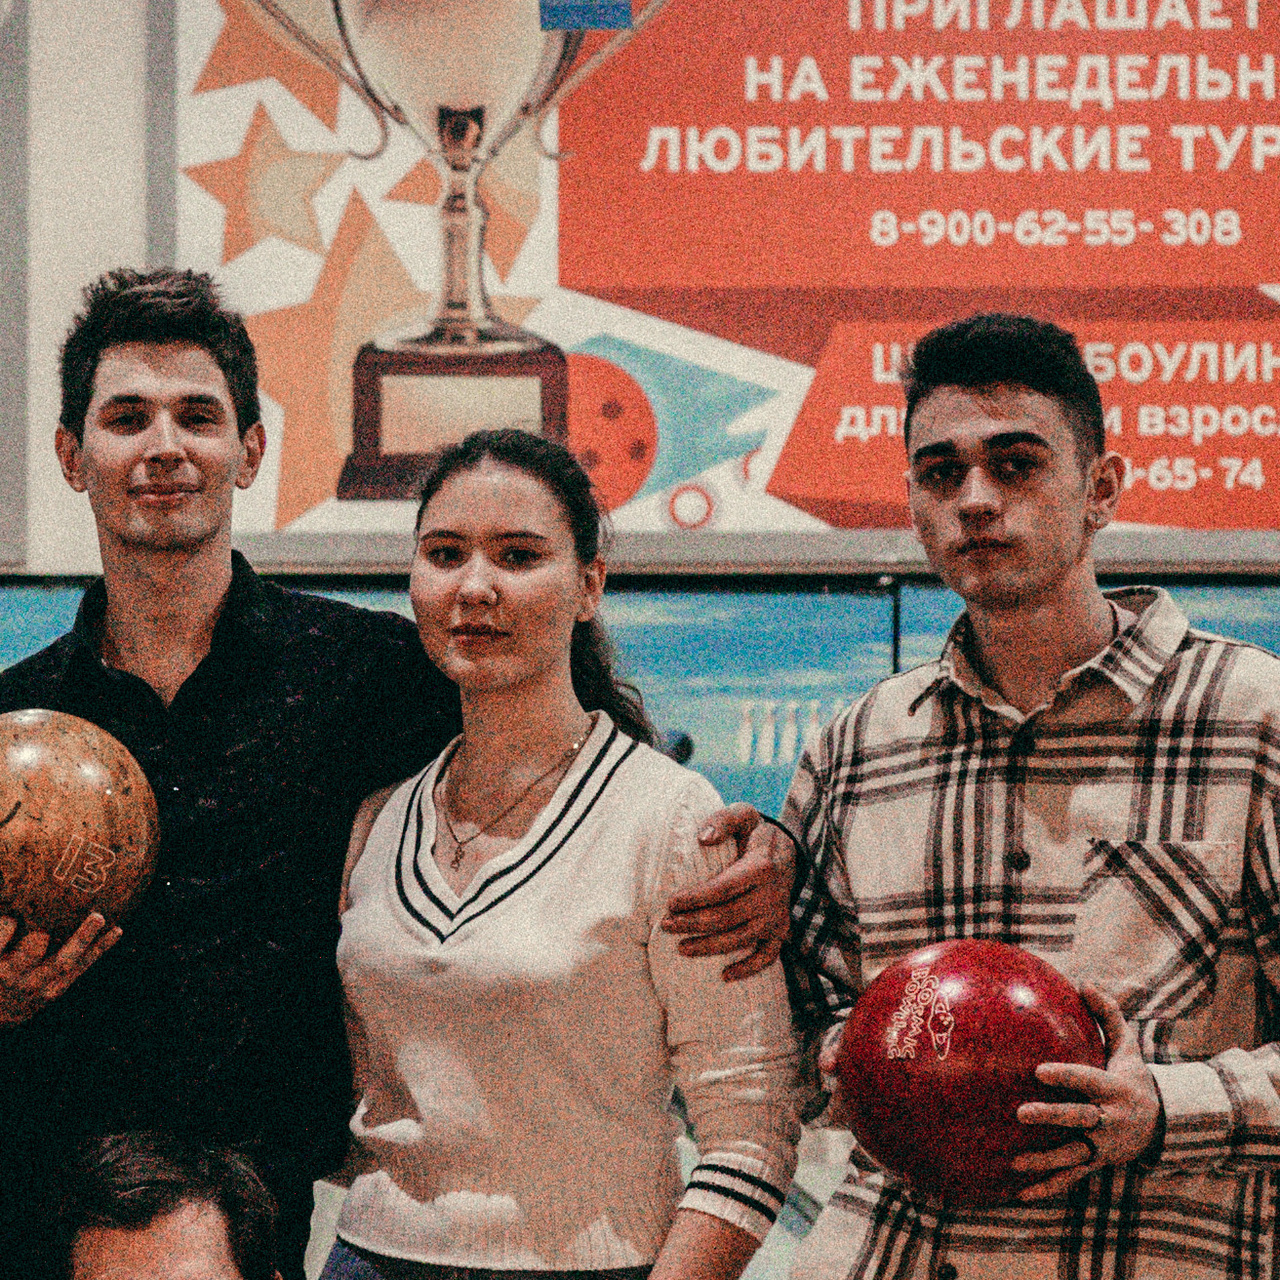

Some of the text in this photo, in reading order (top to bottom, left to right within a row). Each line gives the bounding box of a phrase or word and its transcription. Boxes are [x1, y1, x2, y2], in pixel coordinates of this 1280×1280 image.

[744, 54, 1277, 111] НА ЕЖЕНЕДЕЛЬН
[640, 125, 1280, 173] ЛЮБИТЕЛЬСКИЕ ТУР
[834, 405, 904, 444] дл
[1137, 405, 1280, 447] взрос
